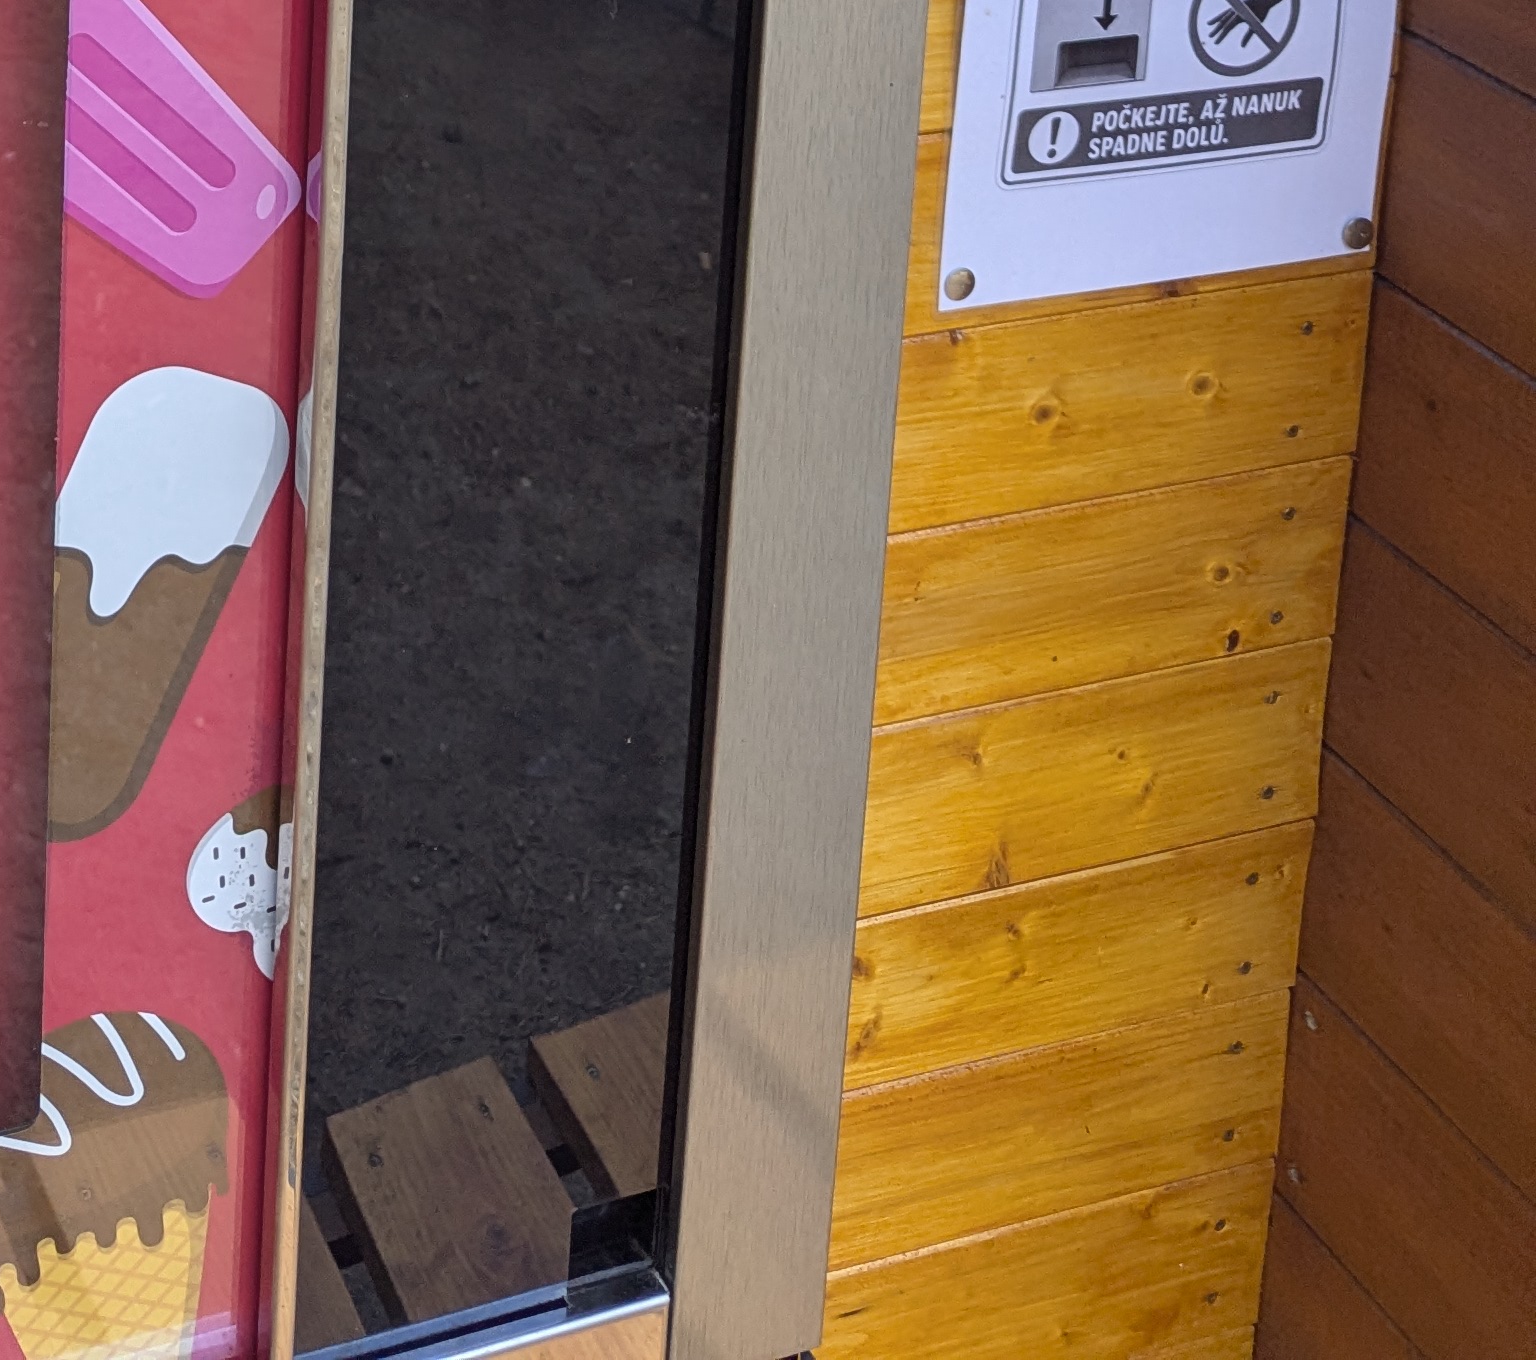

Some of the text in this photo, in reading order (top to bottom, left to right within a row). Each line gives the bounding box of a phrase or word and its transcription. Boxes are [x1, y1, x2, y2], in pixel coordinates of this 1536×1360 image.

[1091, 88, 1303, 133] POČKEJTE, AŽ NANUK
[1087, 122, 1229, 159] SPADNE DOLŮ.
